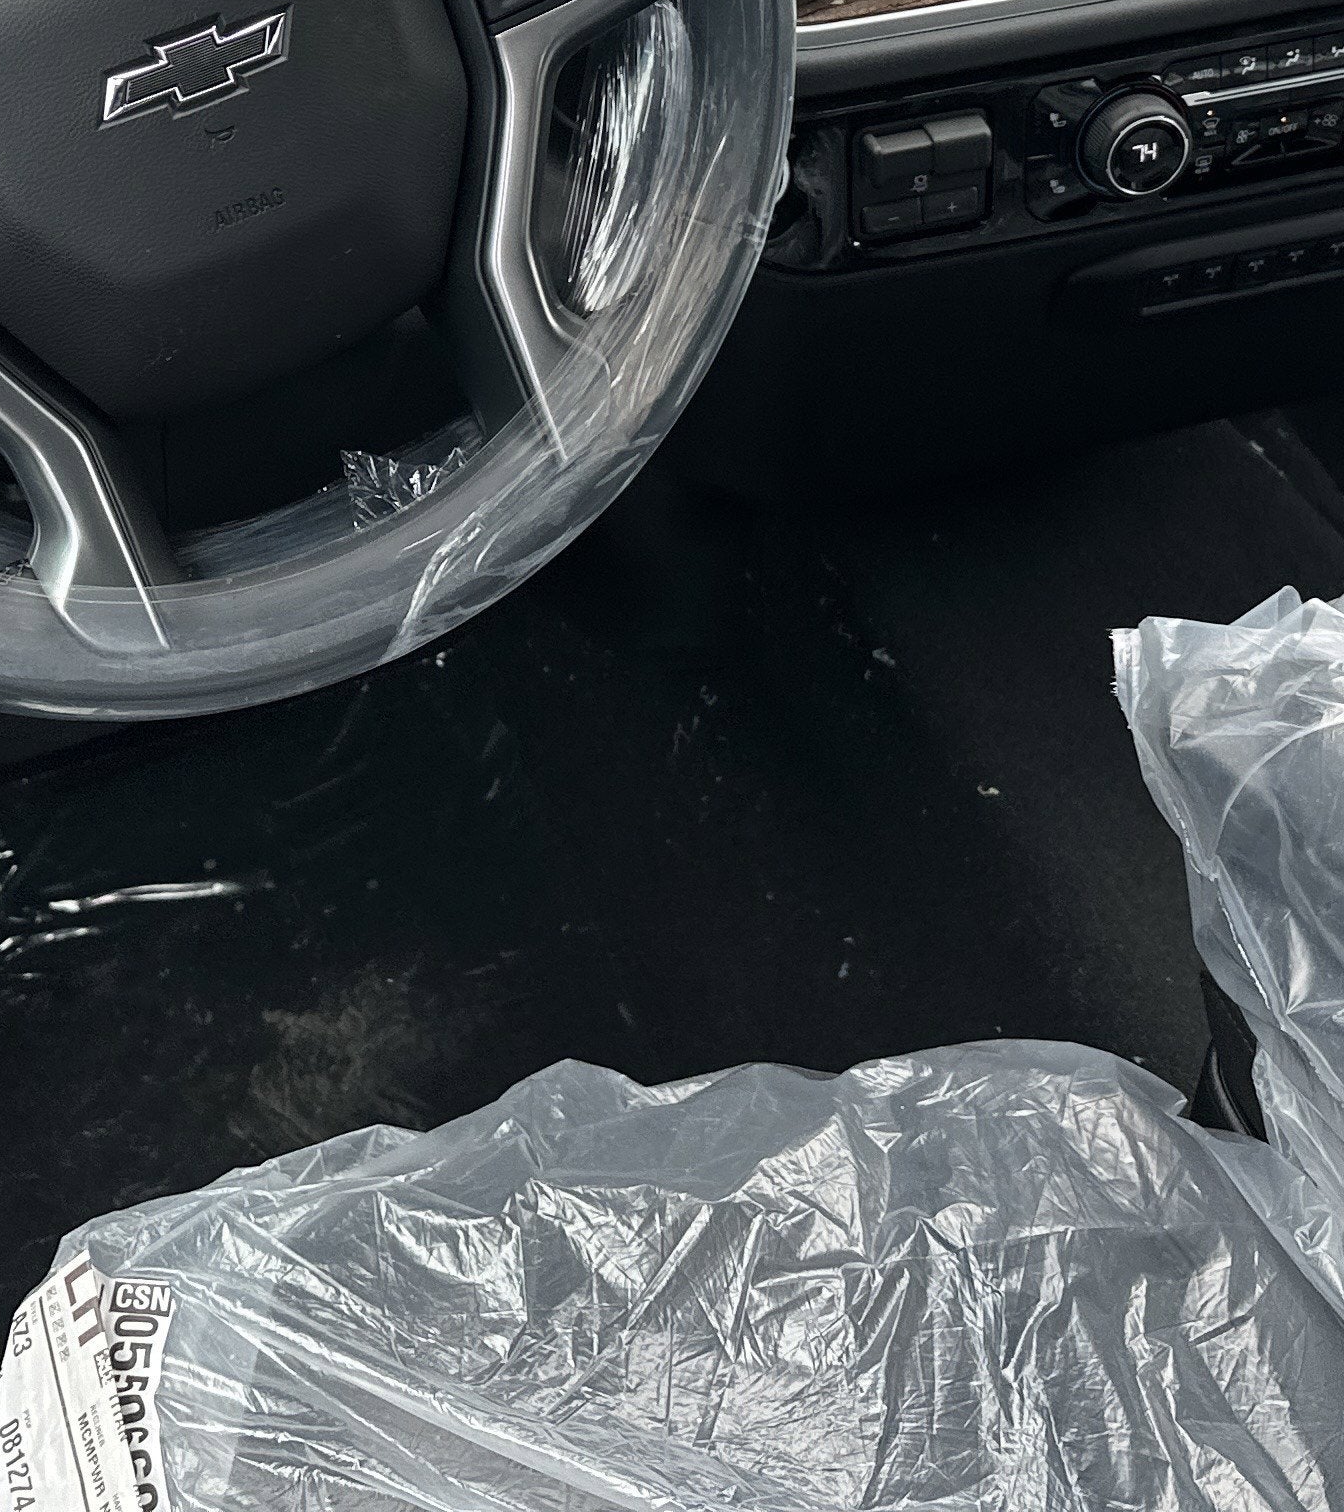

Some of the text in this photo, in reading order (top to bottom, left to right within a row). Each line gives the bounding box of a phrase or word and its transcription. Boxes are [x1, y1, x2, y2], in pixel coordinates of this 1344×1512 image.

[1132, 142, 1157, 162] 74
[116, 1284, 171, 1312] CSN
[11, 1311, 32, 1357] AZ3
[0, 1418, 36, 1512] 081274
[78, 1412, 106, 1497] MCMPWR
